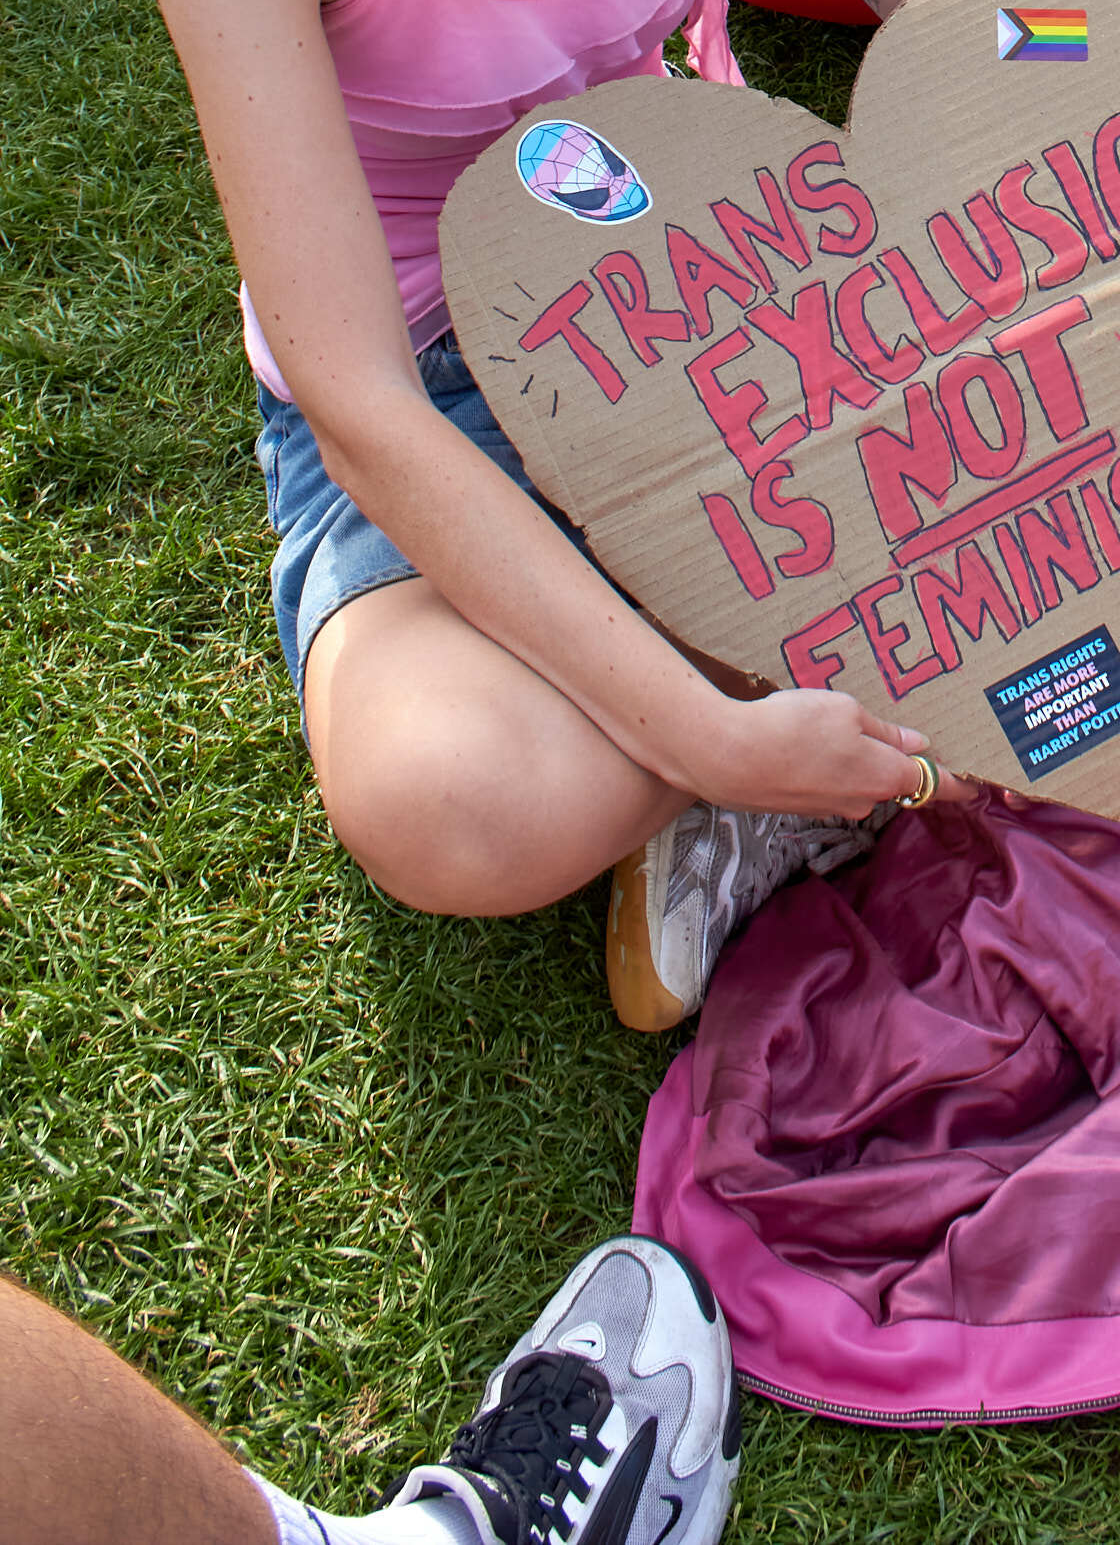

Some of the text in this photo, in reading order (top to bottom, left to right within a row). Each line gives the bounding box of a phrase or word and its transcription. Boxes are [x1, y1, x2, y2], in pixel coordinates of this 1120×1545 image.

[518, 141, 879, 405] TRANS
[699, 294, 1092, 601] IS NOT
[997, 637, 1108, 706] TRANS RIGHTS
[1024, 661, 1099, 713] ARE MORE
[1023, 672, 1111, 731] IMPORTANT
[1052, 699, 1098, 733] THAN
[1028, 726, 1080, 767] HARRY
